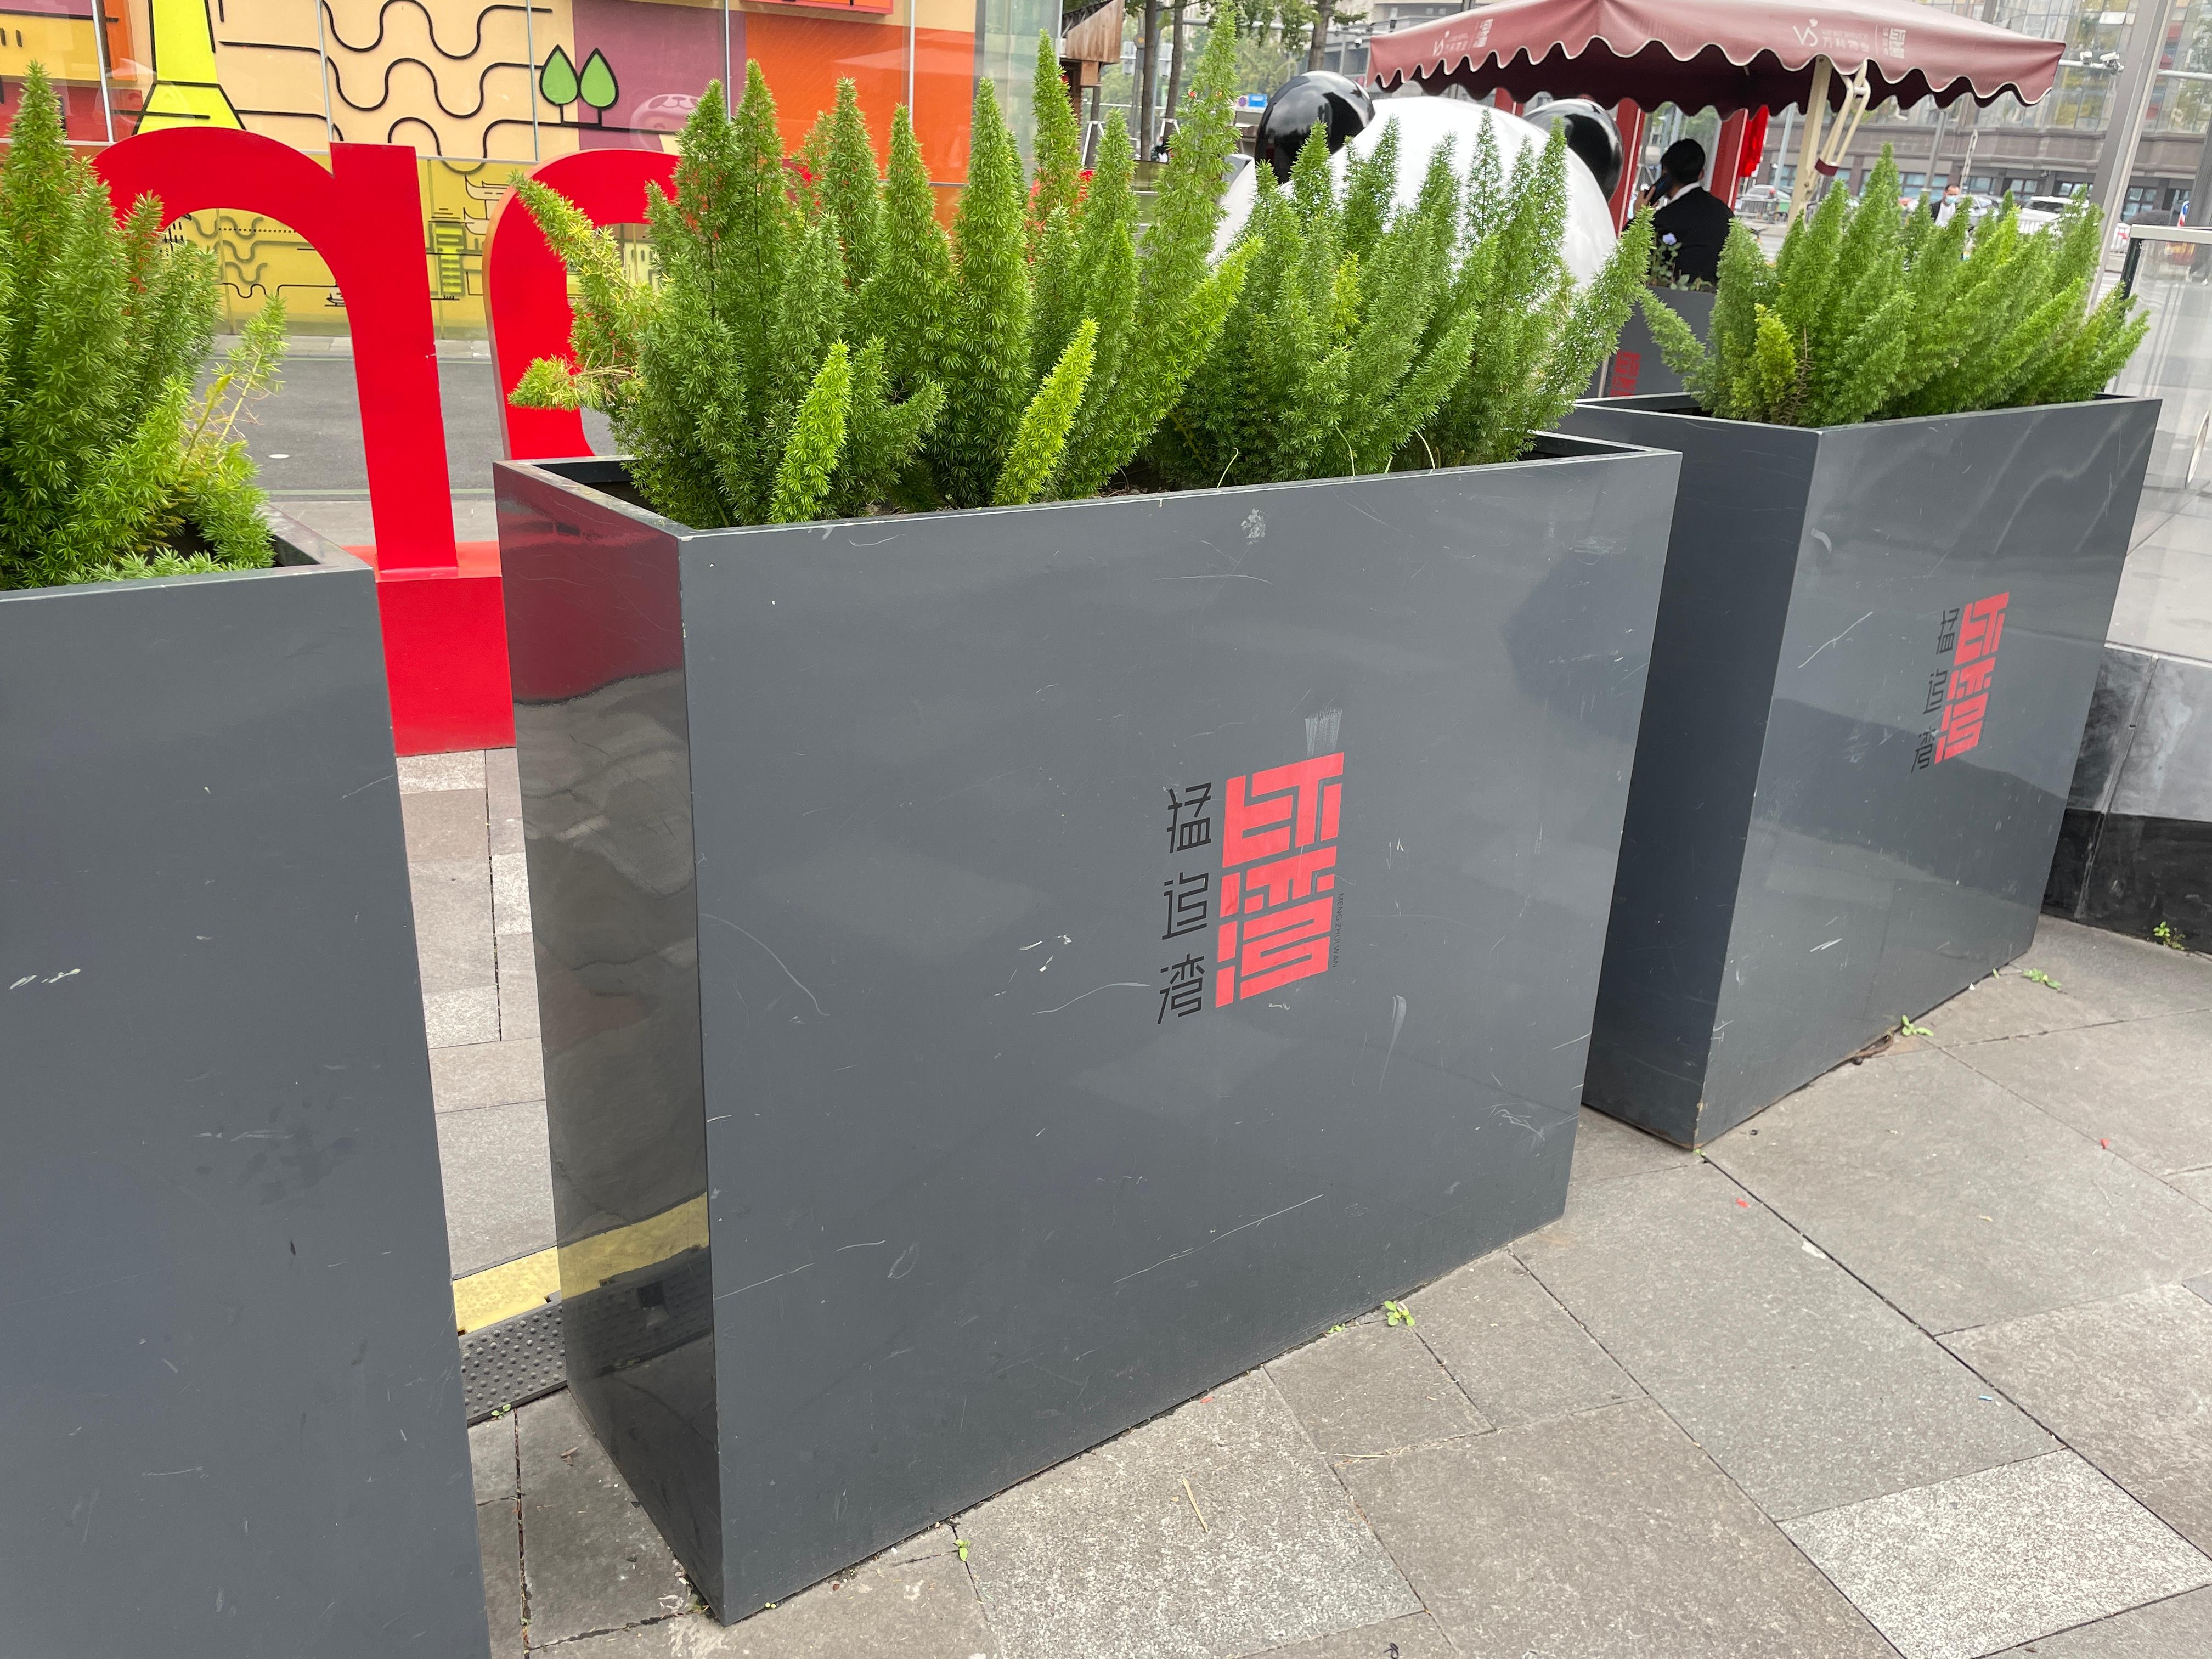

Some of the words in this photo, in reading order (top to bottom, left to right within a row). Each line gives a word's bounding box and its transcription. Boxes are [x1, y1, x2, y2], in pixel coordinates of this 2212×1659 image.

[1335, 893, 1344, 921] MENG
[1334, 923, 1342, 944] ZHUI
[1332, 945, 1340, 968] WAN
